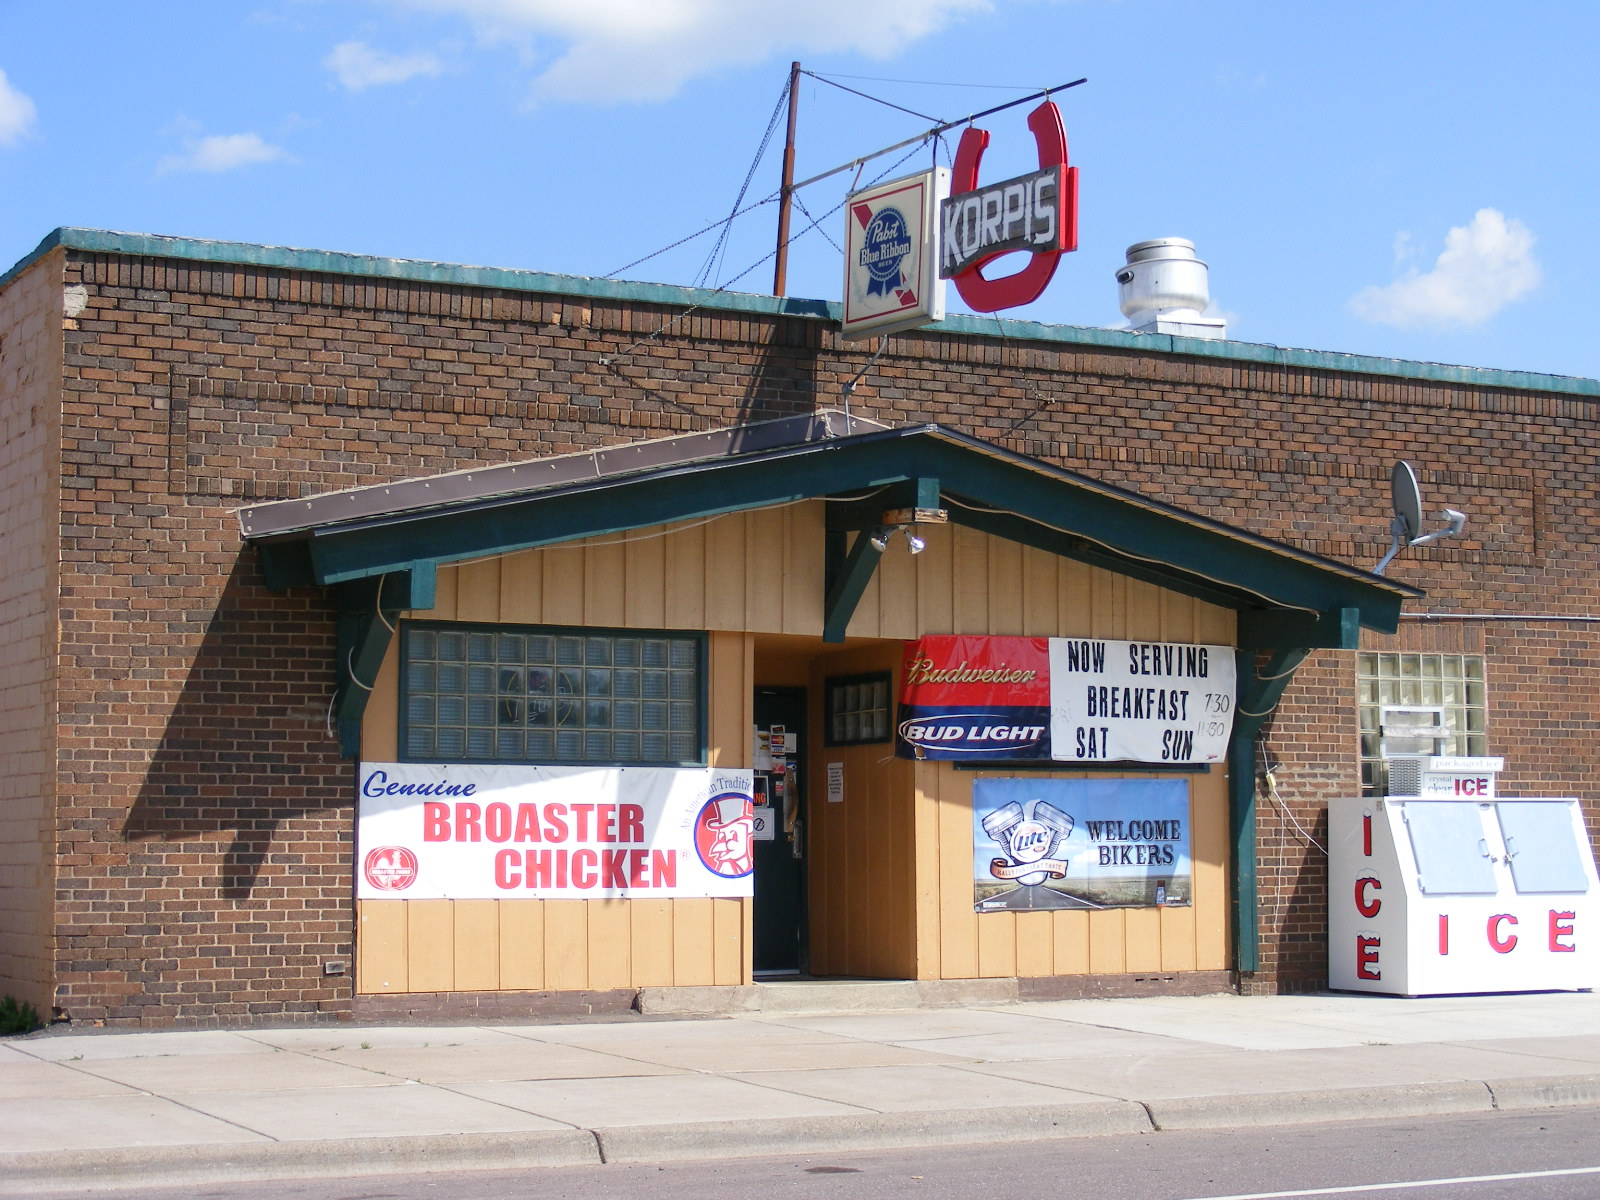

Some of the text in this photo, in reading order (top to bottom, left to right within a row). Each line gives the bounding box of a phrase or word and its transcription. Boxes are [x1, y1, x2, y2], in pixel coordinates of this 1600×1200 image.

[871, 220, 899, 244] Pabst
[943, 172, 1055, 268] KORPIS
[861, 241, 910, 265] Blue Ribbon
[905, 659, 1037, 685] Budweiser
[1068, 641, 1208, 678] NOW SERVING
[1087, 686, 1189, 721] BREAKFAST
[906, 726, 1045, 741] BUD LIGHT
[1076, 727, 1193, 760] SAT SUN
[1435, 759, 1482, 768] packaged
[363, 770, 476, 798] Genuine
[1455, 777, 1488, 796] ICE
[423, 801, 644, 843] BROASTER
[1085, 820, 1181, 841] WELCOME
[1017, 831, 1048, 851] Lite
[494, 848, 677, 890] CHICKEN
[1098, 844, 1174, 867] BIKERS
[1355, 808, 1382, 980] ICE
[1438, 909, 1576, 956] ICE
